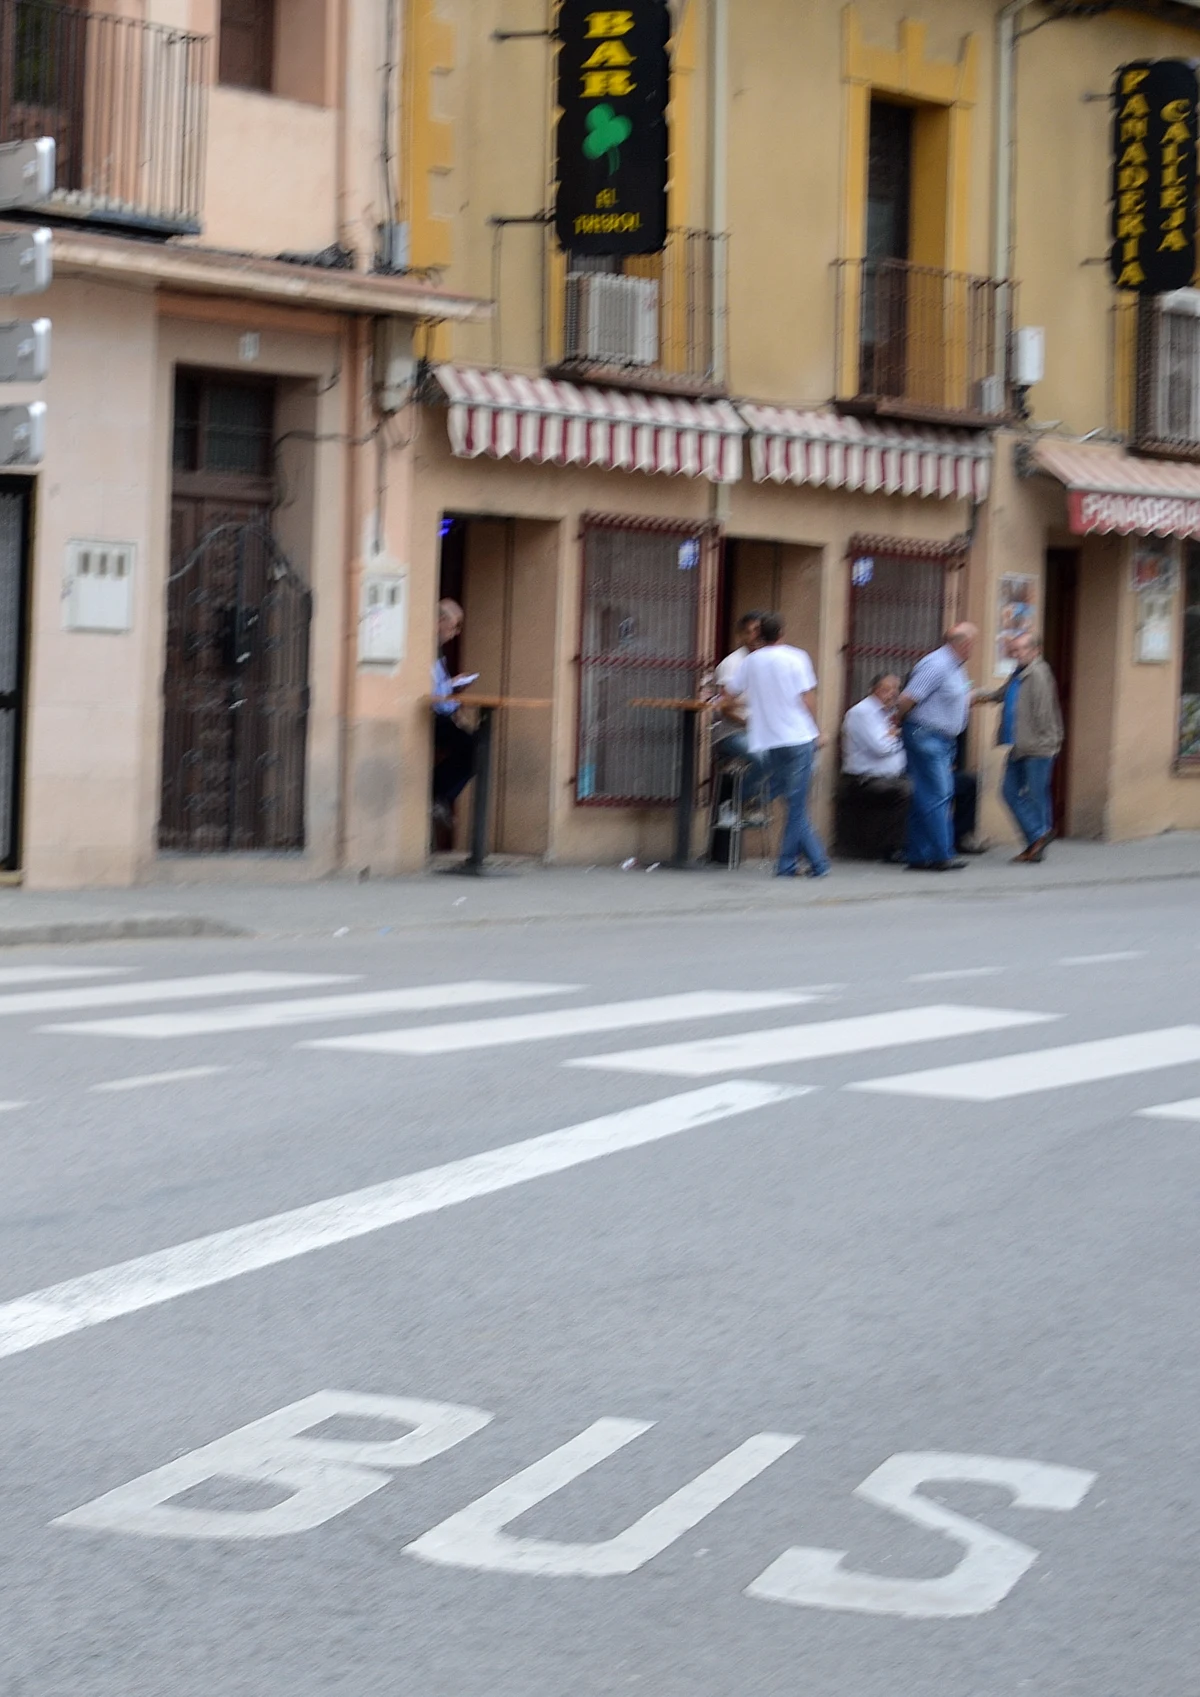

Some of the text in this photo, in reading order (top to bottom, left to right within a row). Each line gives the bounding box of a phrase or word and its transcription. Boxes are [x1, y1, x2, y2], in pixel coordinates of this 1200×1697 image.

[579, 10, 638, 98] BAR
[1155, 98, 1193, 252] CALLEJA
[47, 1389, 1097, 1619] BUS
